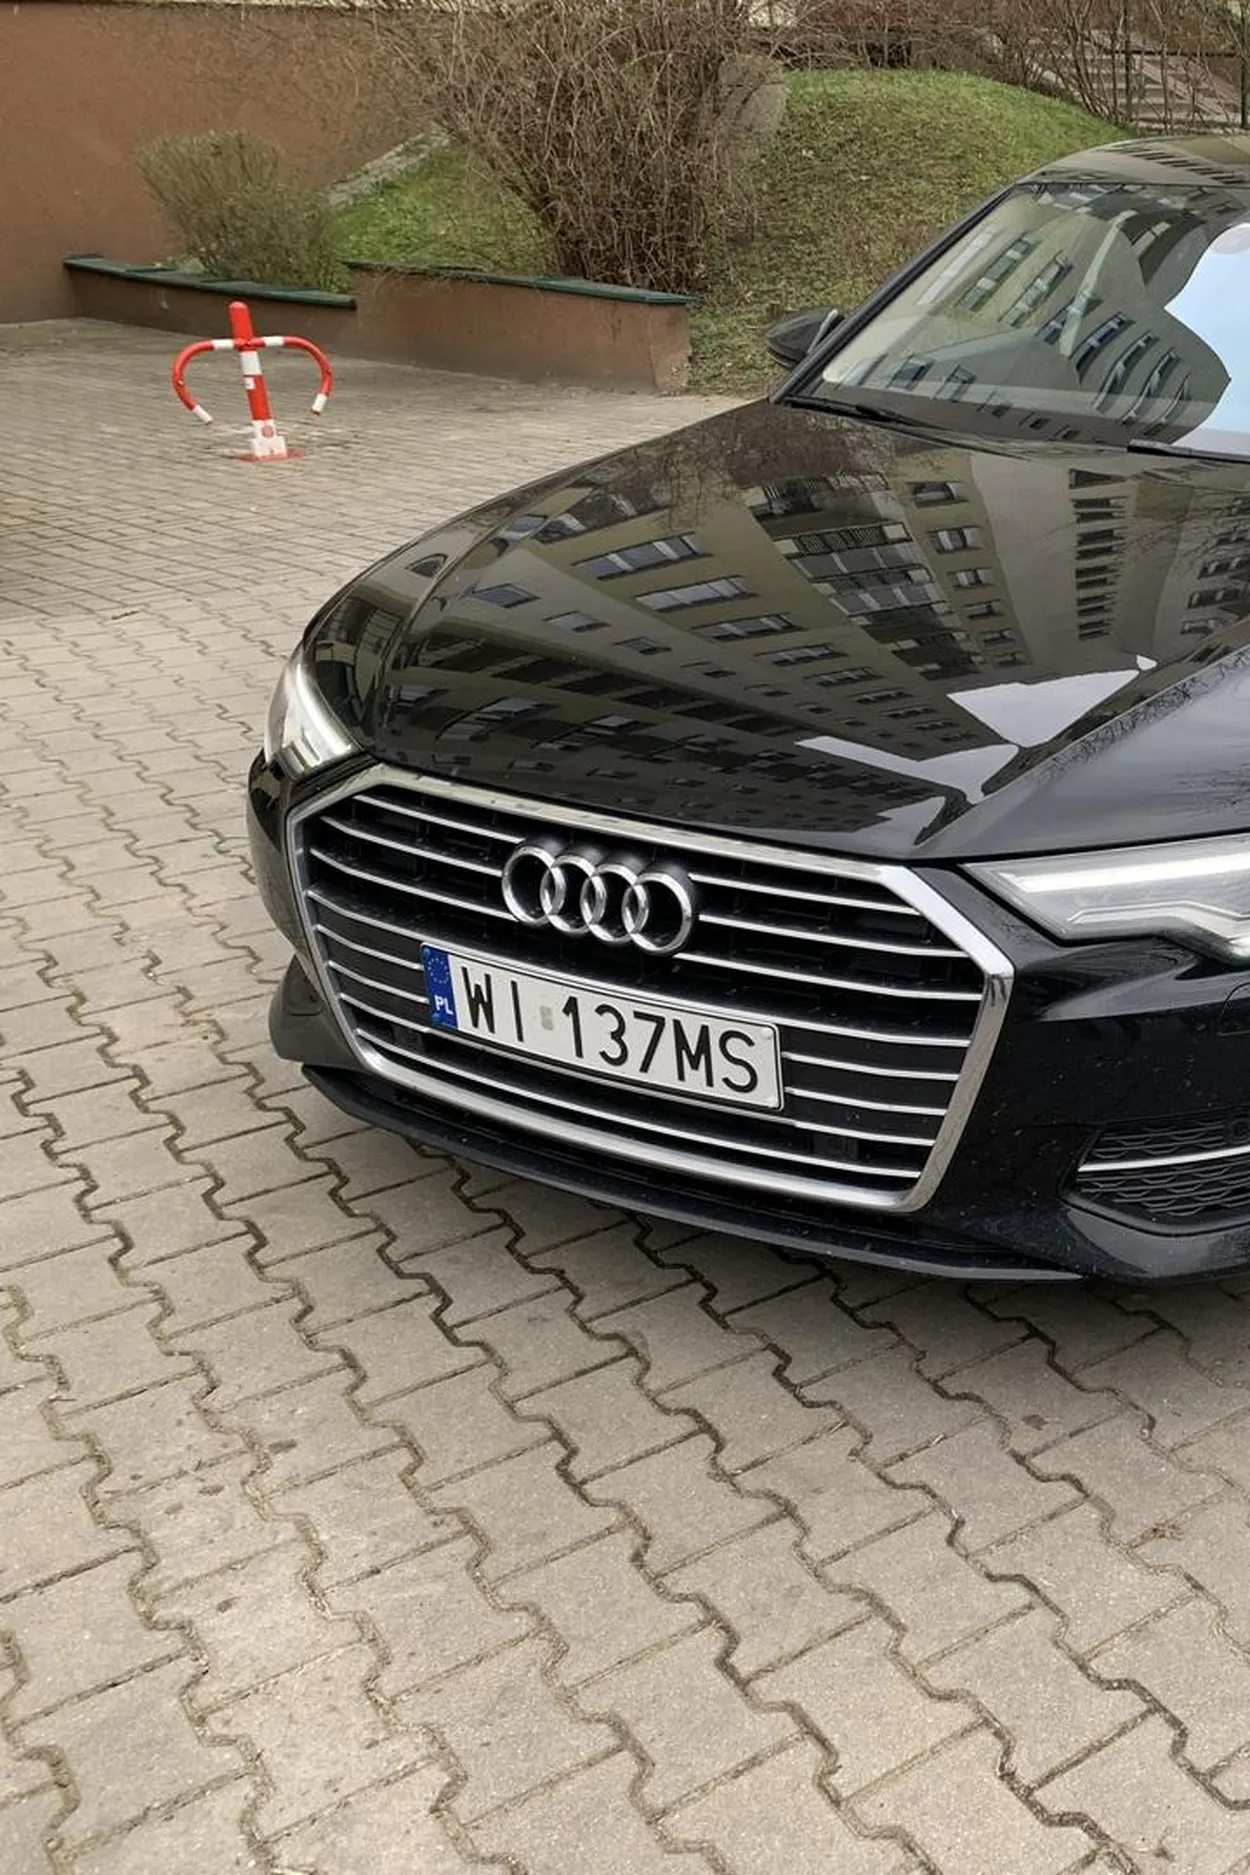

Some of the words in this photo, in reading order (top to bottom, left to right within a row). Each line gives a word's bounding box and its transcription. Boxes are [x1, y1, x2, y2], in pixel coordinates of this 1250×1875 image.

[434, 993, 454, 1016] PL
[460, 965, 525, 1043] WI
[562, 995, 759, 1094] 137MS
